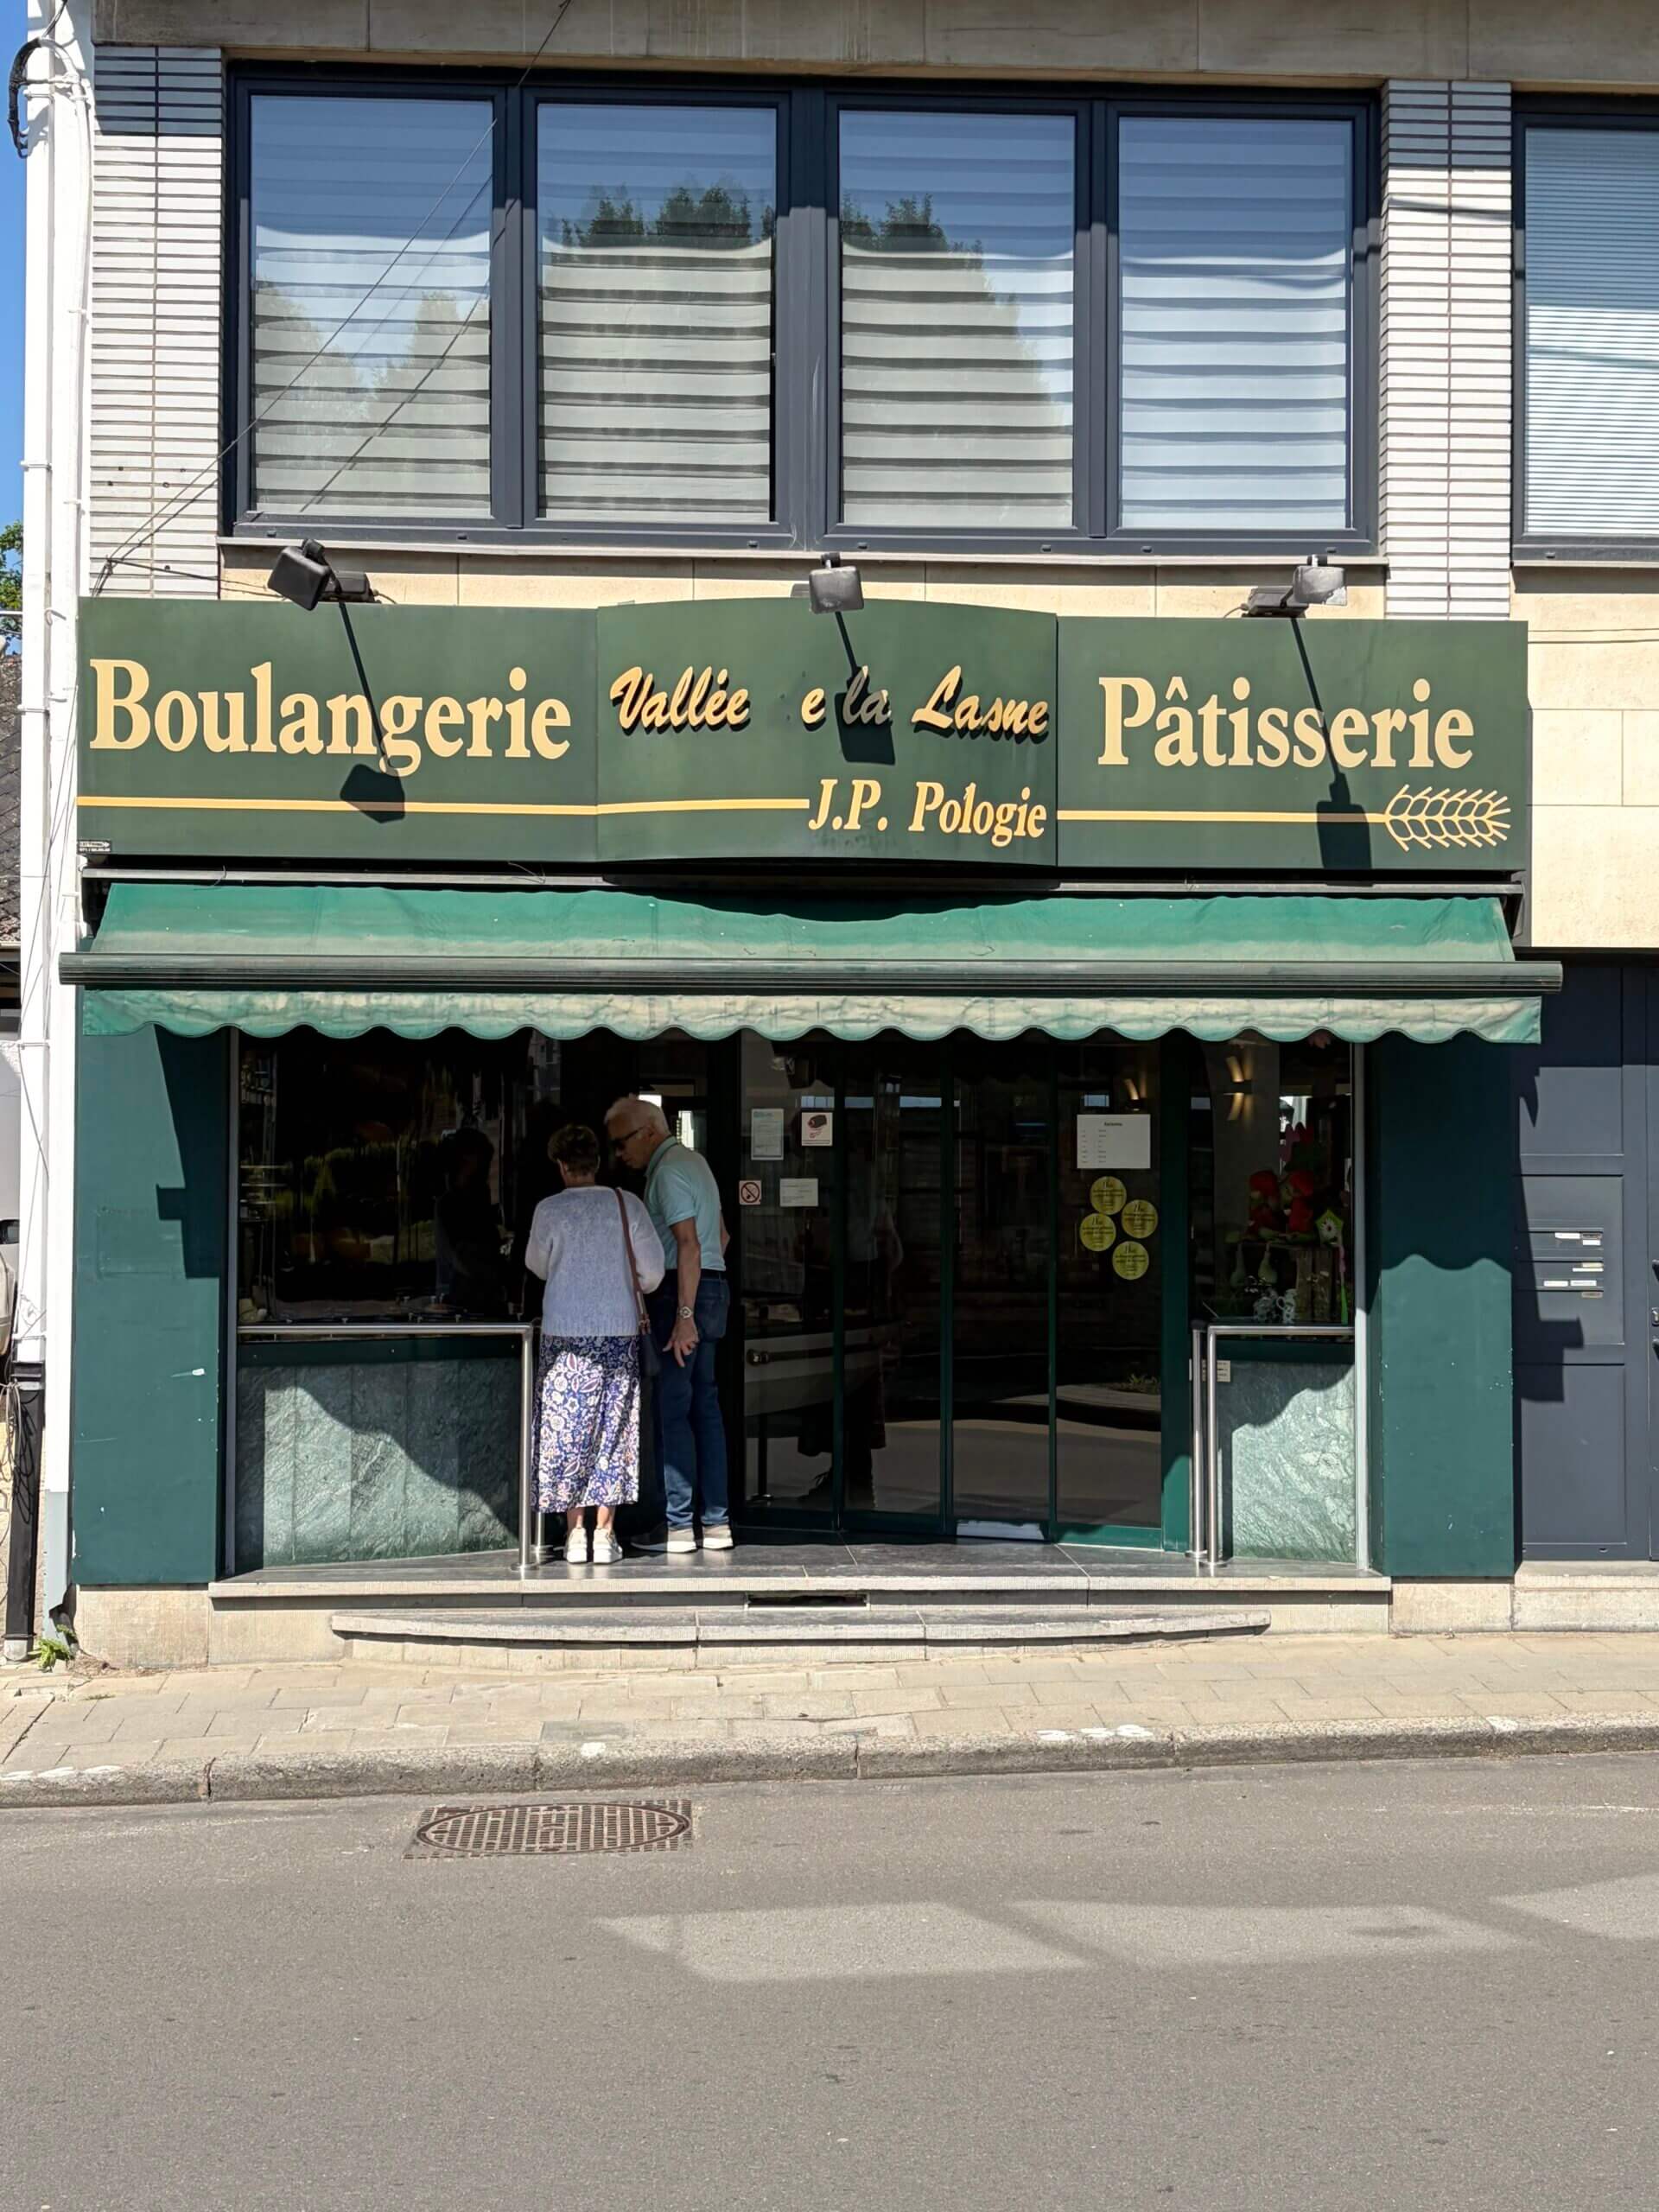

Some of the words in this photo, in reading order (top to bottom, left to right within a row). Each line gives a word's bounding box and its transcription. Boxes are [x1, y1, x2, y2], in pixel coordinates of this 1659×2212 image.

[89, 658, 571, 777] Boulangerie
[609, 664, 749, 729] Vallée
[842, 665, 893, 727] la
[911, 664, 1049, 734] Lasne
[1097, 677, 1474, 769] Pâtisserie
[809, 779, 888, 831] J.P.
[908, 781, 1047, 849] Pologie
